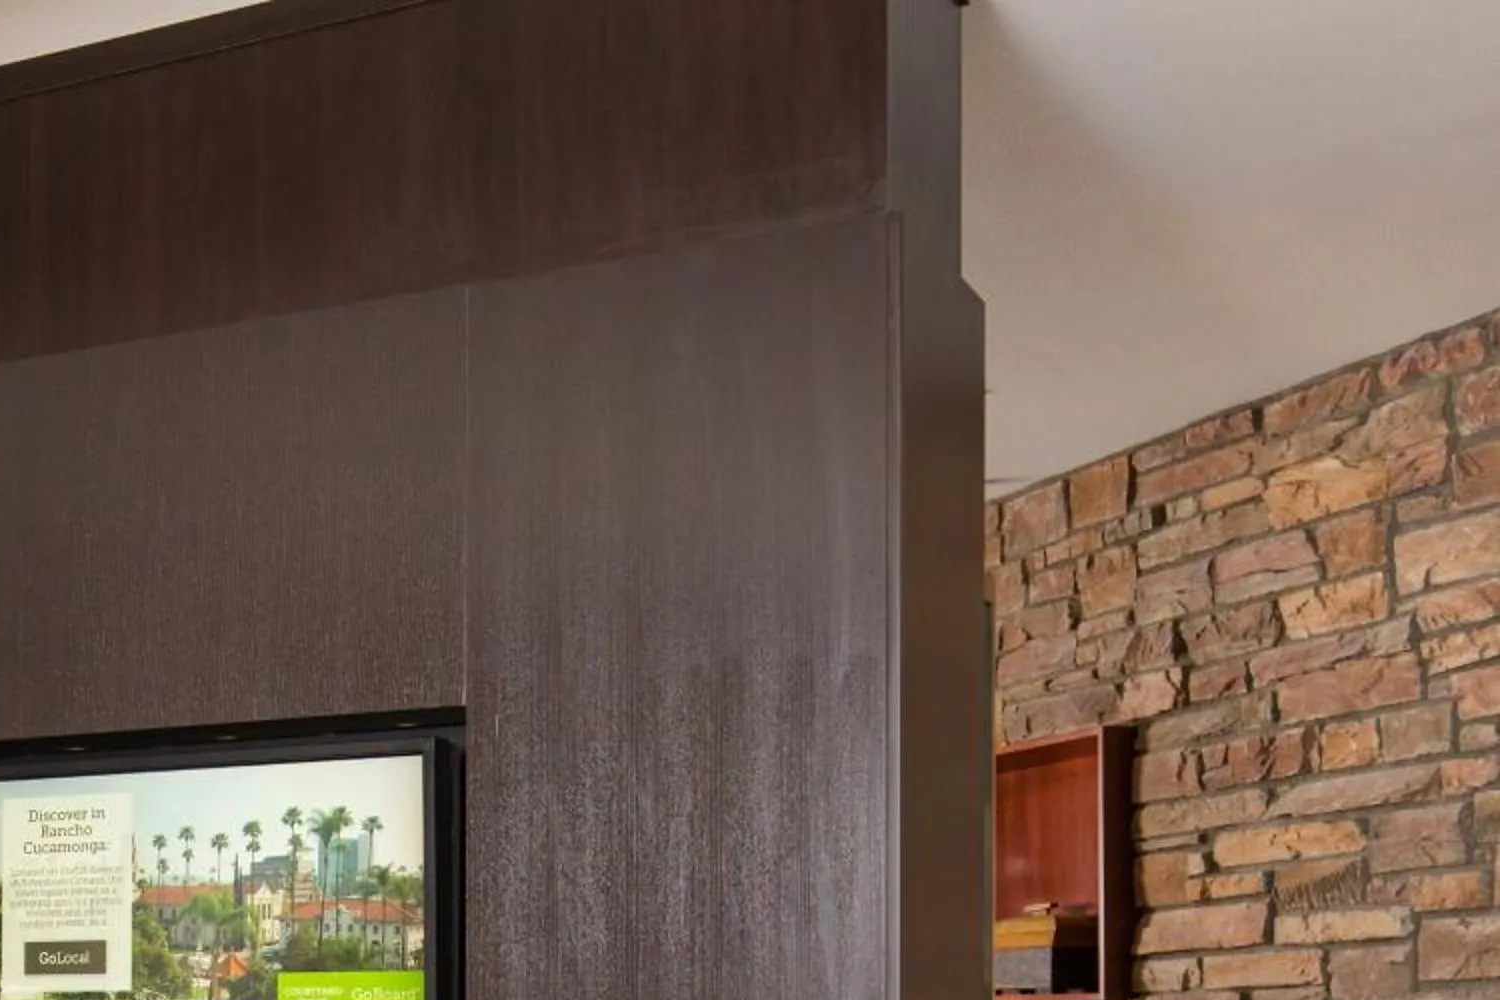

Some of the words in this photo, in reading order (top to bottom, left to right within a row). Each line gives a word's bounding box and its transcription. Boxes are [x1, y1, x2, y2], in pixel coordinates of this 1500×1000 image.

[28, 809, 87, 823] Discover
[91, 808, 106, 819] in
[41, 824, 92, 838] Rancho
[39, 951, 90, 965] GoLocal
